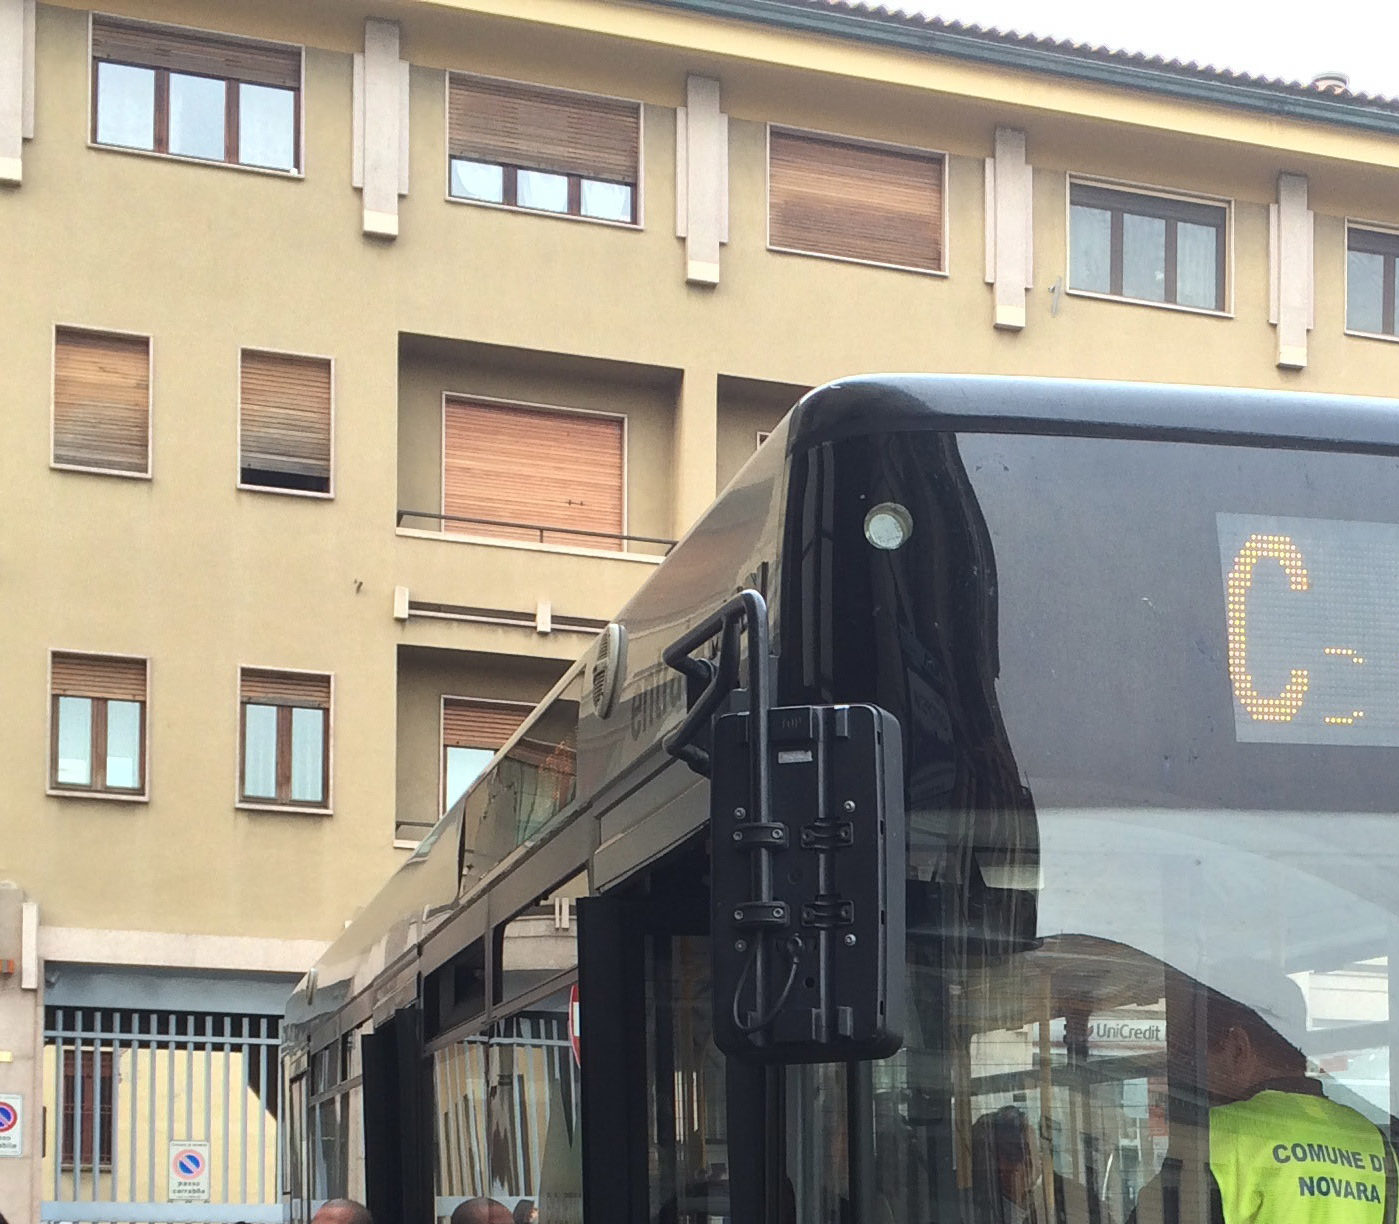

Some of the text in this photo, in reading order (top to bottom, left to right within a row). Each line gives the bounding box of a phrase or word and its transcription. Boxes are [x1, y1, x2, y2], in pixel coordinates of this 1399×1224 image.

[1228, 533, 1309, 721] C
[1096, 1024, 1161, 1041] UniCredit
[1272, 1142, 1366, 1170] COMUNE
[1298, 1175, 1381, 1204] NOVARA
